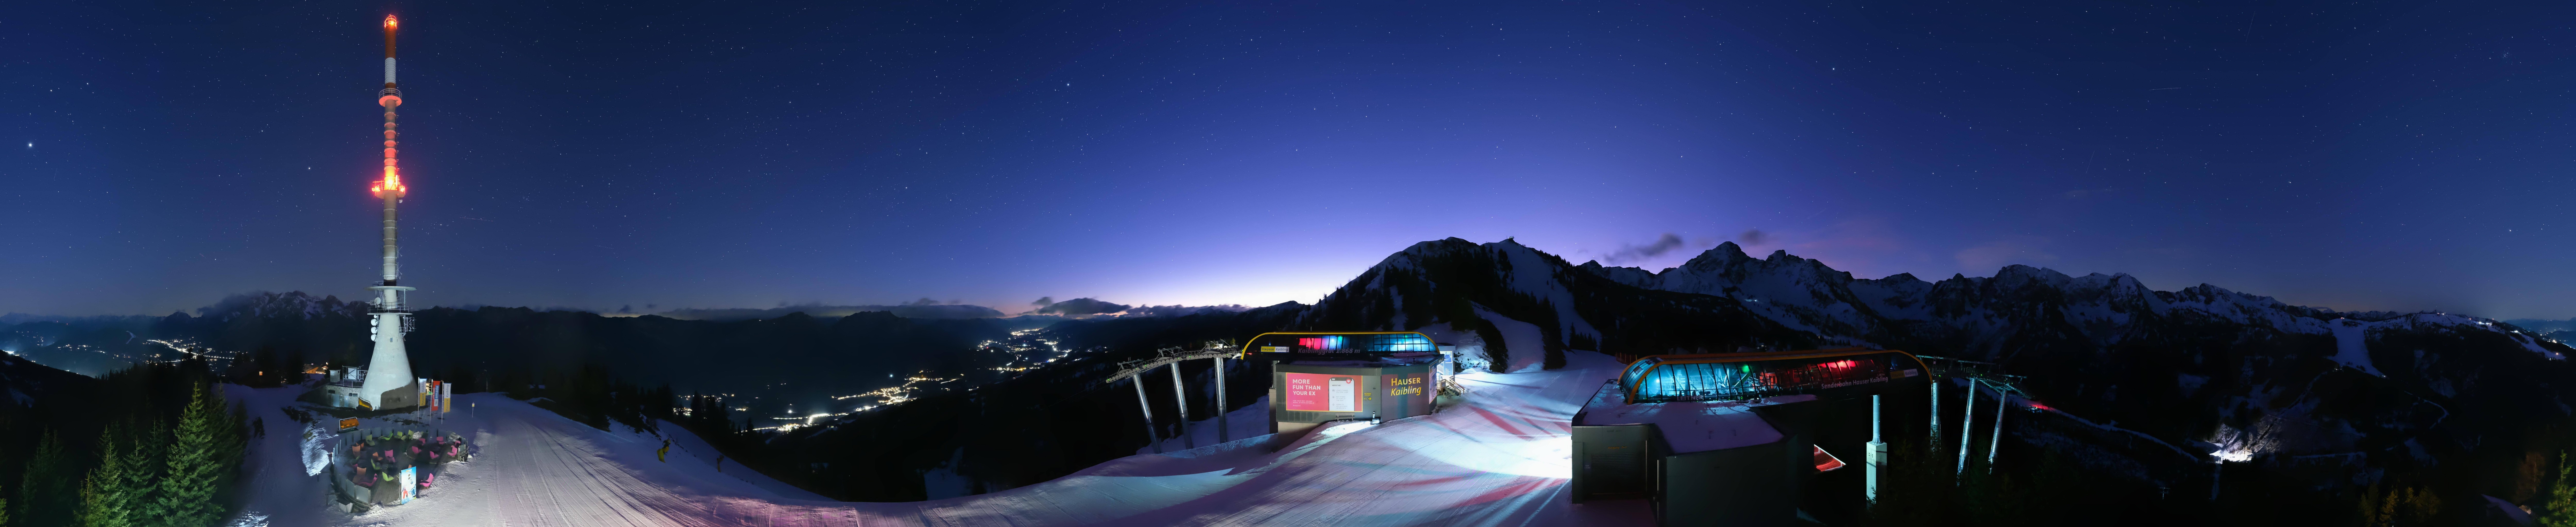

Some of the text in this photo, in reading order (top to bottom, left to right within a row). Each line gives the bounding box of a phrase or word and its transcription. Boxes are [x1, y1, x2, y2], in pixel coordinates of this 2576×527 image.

[1391, 377, 1421, 386] HAUSER
[1821, 380, 1851, 389] Senderbahn
[1391, 386, 1421, 396] Kaibling
